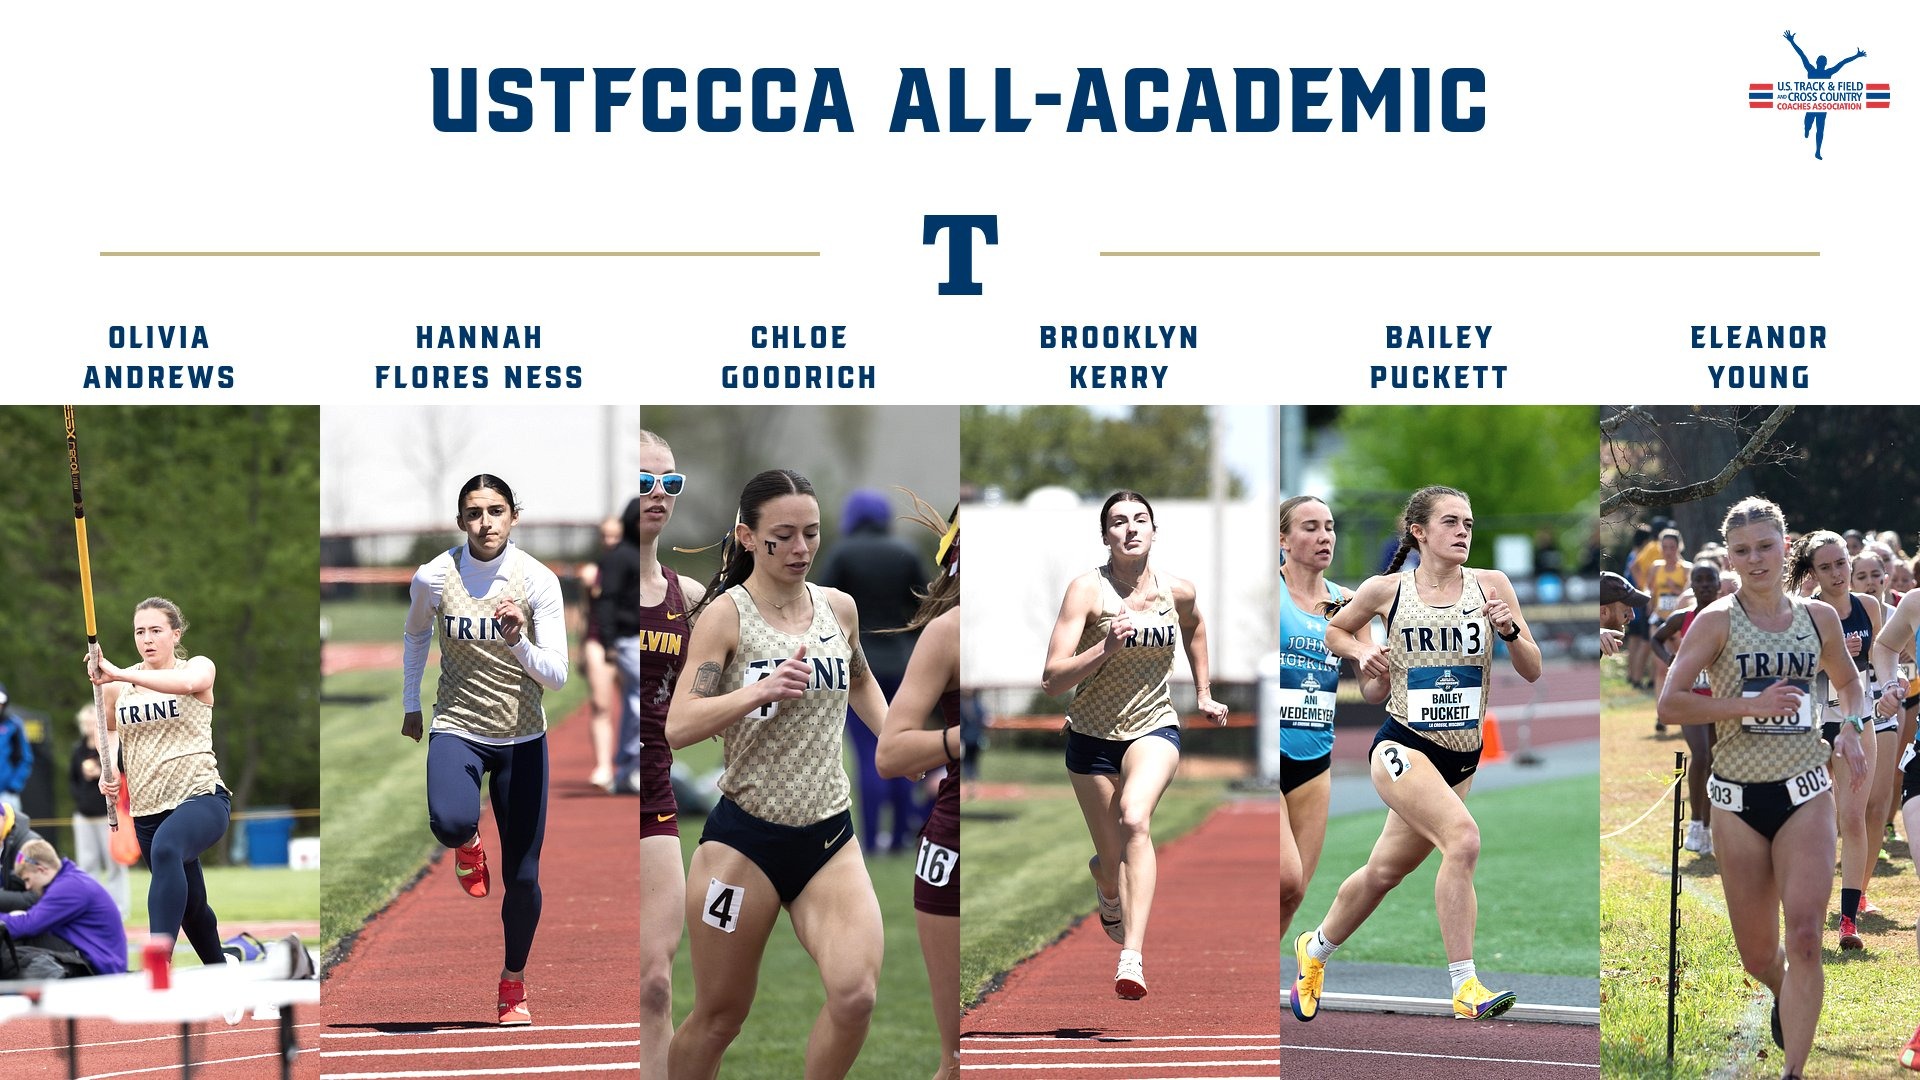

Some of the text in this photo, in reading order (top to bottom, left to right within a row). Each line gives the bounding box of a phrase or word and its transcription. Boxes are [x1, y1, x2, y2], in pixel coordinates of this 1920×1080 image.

[765, 540, 776, 555] T
[445, 615, 506, 639] TRIN
[1126, 625, 1174, 648] RINE
[1401, 627, 1463, 652] TRIN
[1467, 622, 1480, 654] 3
[1736, 652, 1815, 679] TRINE
[1304, 695, 1318, 705] ANI
[1432, 693, 1462, 704] BAILEY
[119, 699, 180, 725] TRINE
[1421, 706, 1470, 721] PUCKETT
[1384, 747, 1404, 777] 3
[1796, 766, 1828, 797] 803
[920, 842, 949, 884] 16
[708, 887, 735, 928] 4
